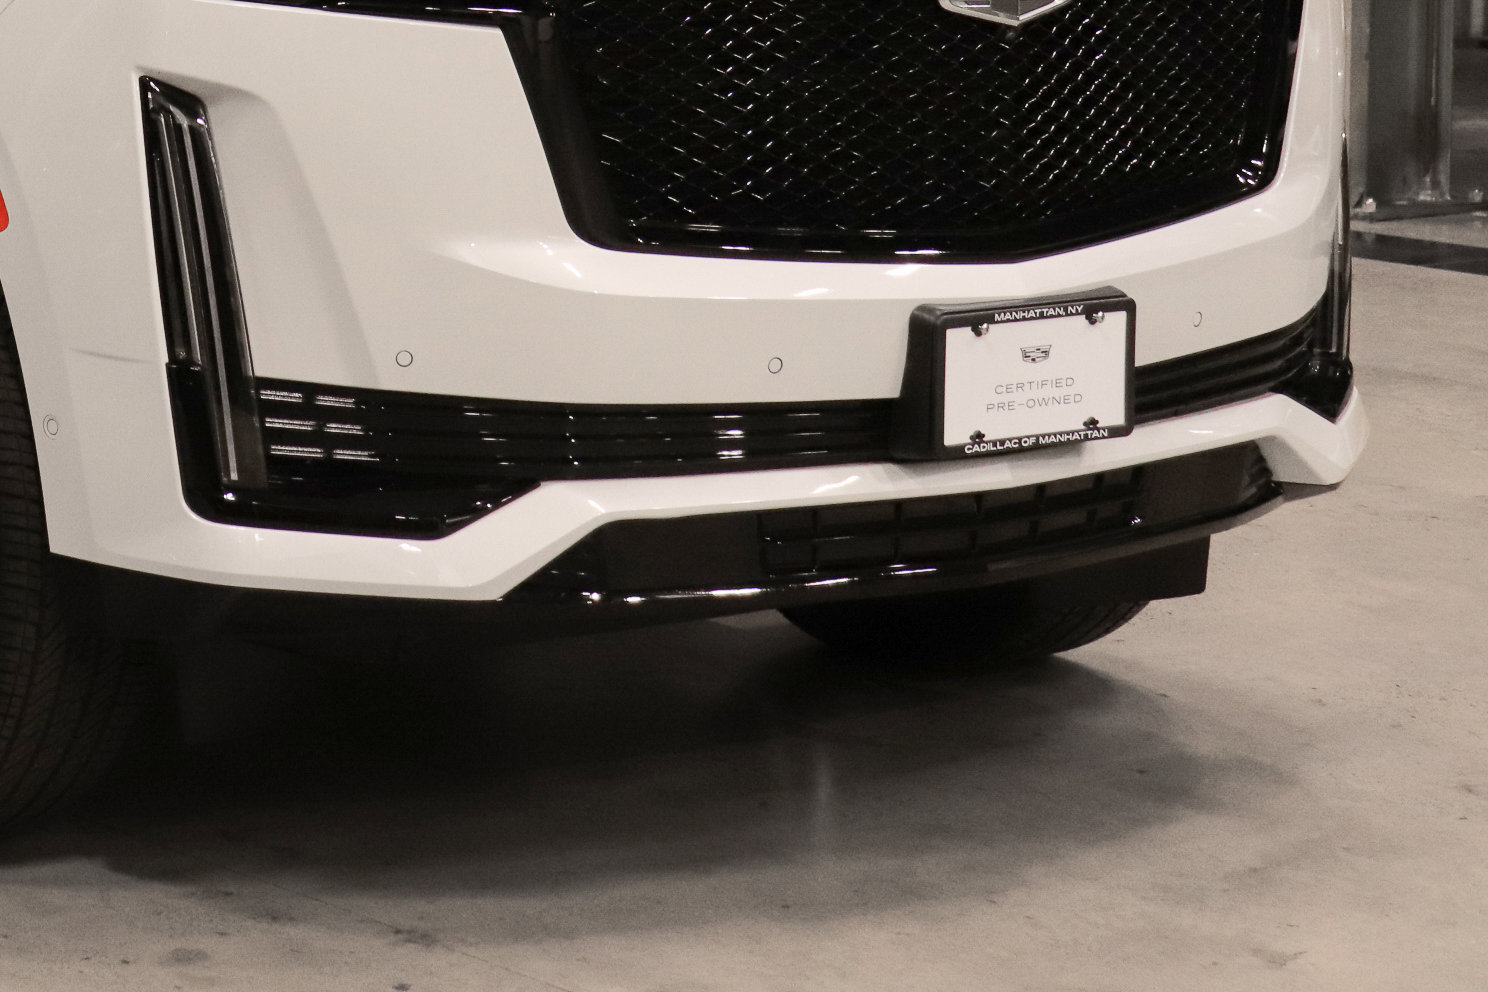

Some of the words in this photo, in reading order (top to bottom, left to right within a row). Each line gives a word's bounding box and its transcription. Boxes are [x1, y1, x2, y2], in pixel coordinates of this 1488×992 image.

[994, 306, 1066, 322] MANHATTAN,
[1067, 304, 1084, 314] NY
[994, 377, 1075, 395] CERTIFIED
[986, 393, 1083, 413] PRE-OWNED
[964, 439, 1019, 454] CADILLAC
[1021, 436, 1037, 447] OF
[1038, 428, 1109, 445] MANHATTAN
